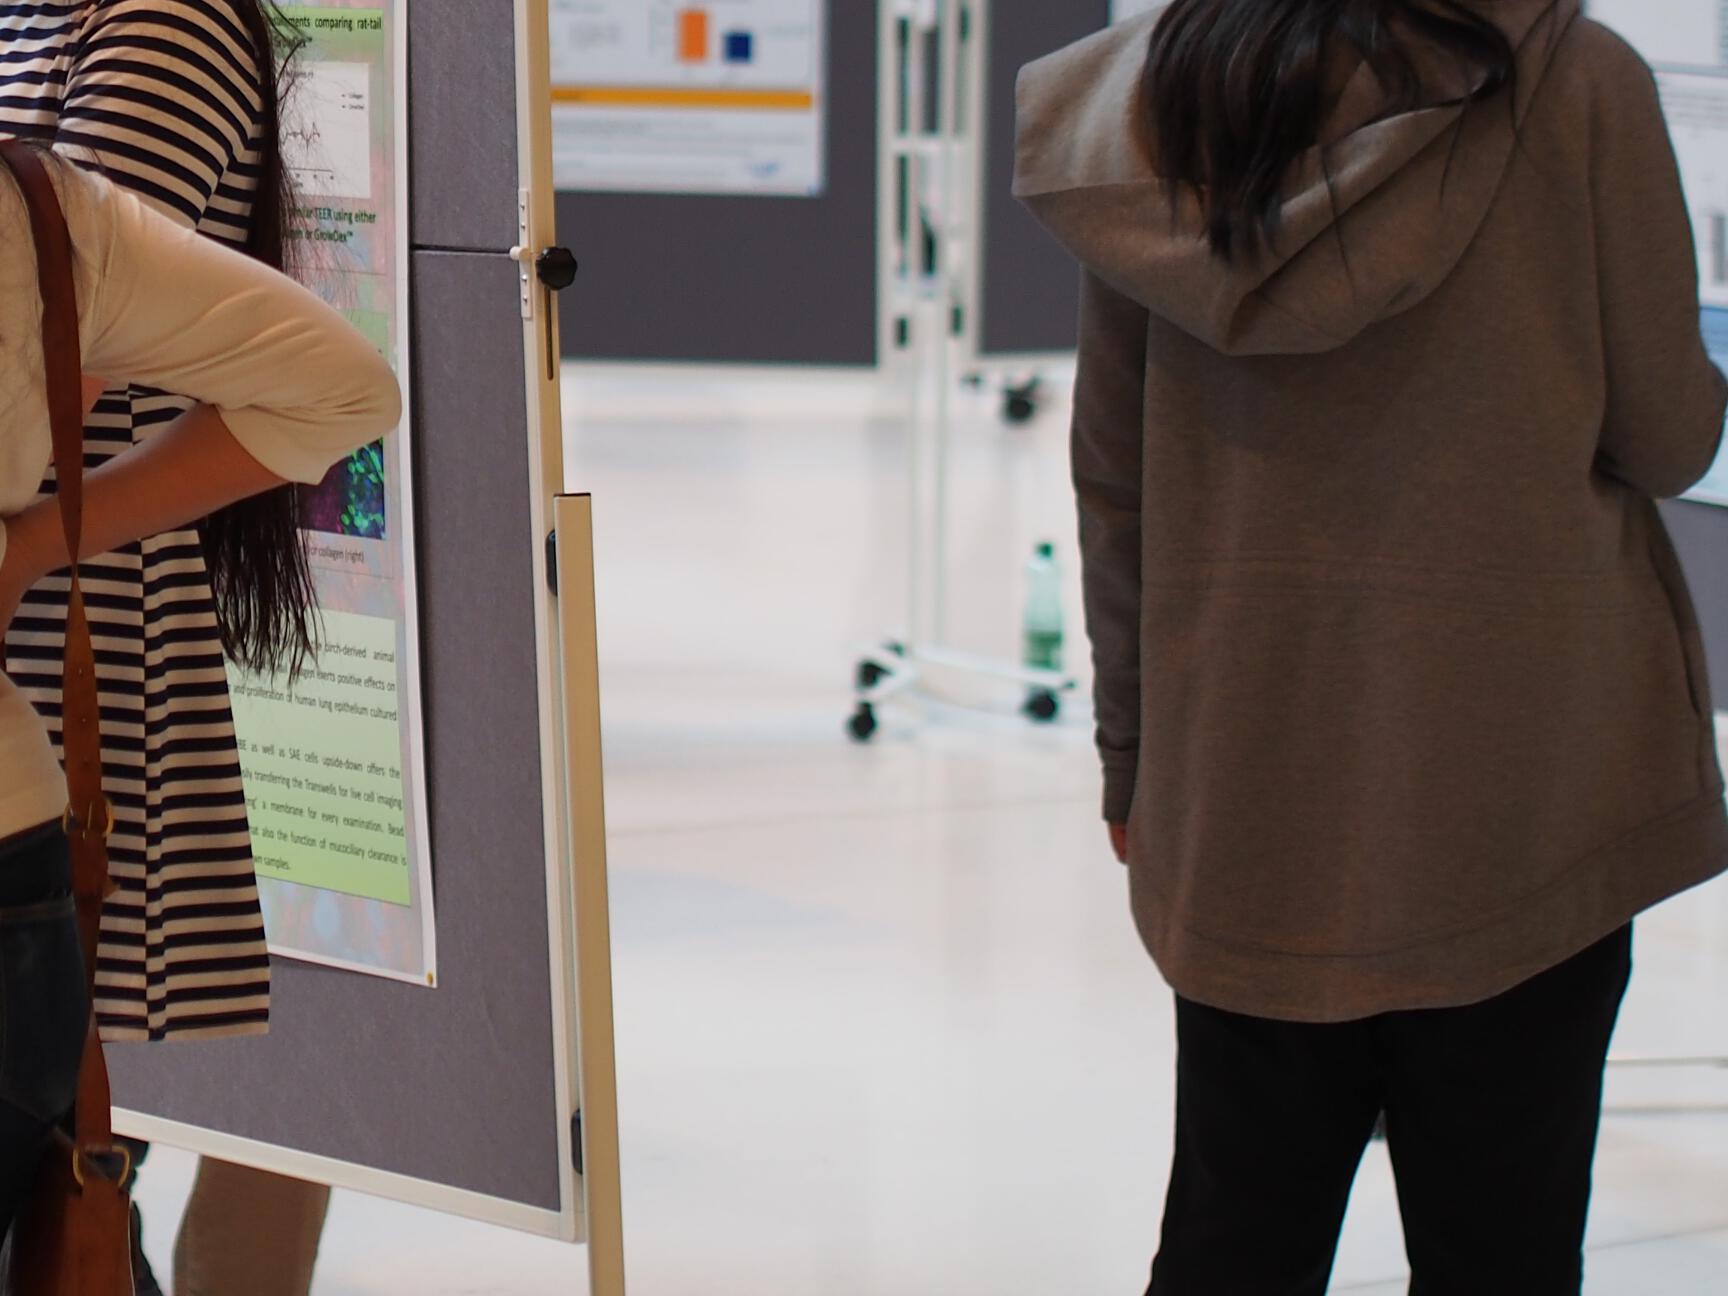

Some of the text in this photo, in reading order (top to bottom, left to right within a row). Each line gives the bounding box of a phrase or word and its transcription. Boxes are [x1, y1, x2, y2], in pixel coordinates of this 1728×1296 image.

[315, 15, 382, 32] comparing rat-tail
[315, 207, 377, 225] TEER using either
[373, 648, 395, 664] animal
[337, 672, 361, 687] positive
[363, 674, 385, 690] effects
[294, 693, 317, 707] human
[334, 699, 368, 716] epithelium
[369, 705, 397, 721] cultured
[262, 742, 275, 755] well
[304, 752, 319, 765] cells
[322, 755, 363, 773] upside-down
[366, 761, 386, 776] offers
[389, 766, 401, 779] the
[254, 771, 402, 811] transferring the Transwells for live cell imaging
[270, 801, 304, 818] membrane
[307, 807, 317, 819] for
[261, 825, 274, 840] also
[276, 828, 288, 842] the
[290, 831, 317, 848] function
[329, 841, 365, 858] mucociliary
[367, 847, 398, 864] clearance
